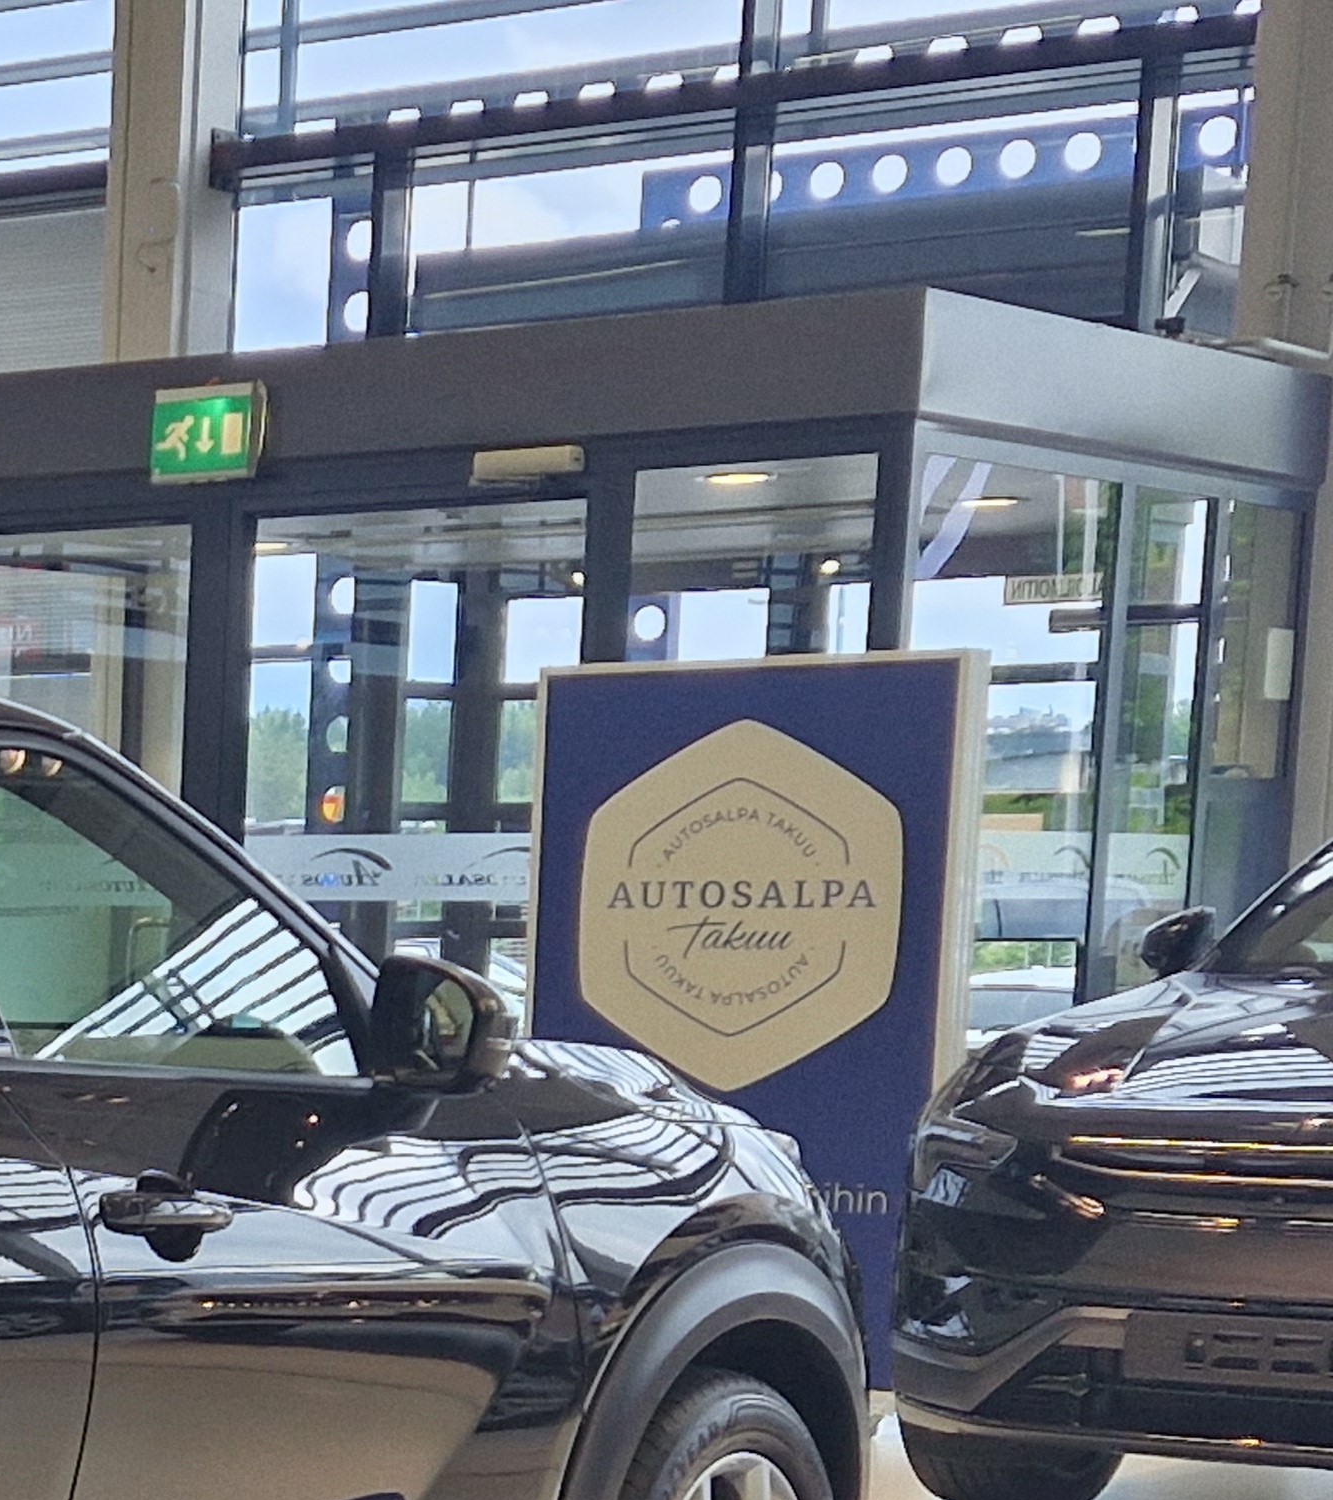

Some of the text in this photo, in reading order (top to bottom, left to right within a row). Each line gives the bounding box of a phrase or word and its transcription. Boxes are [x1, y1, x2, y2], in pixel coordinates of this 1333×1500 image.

[663, 807, 817, 861] AUTOSALPA TAKUU
[607, 880, 877, 909] AUTOSALPA
[667, 915, 793, 959] Takuu
[654, 954, 810, 1006] AUTOSALPA TAKUU
[823, 1182, 888, 1215] ihin
